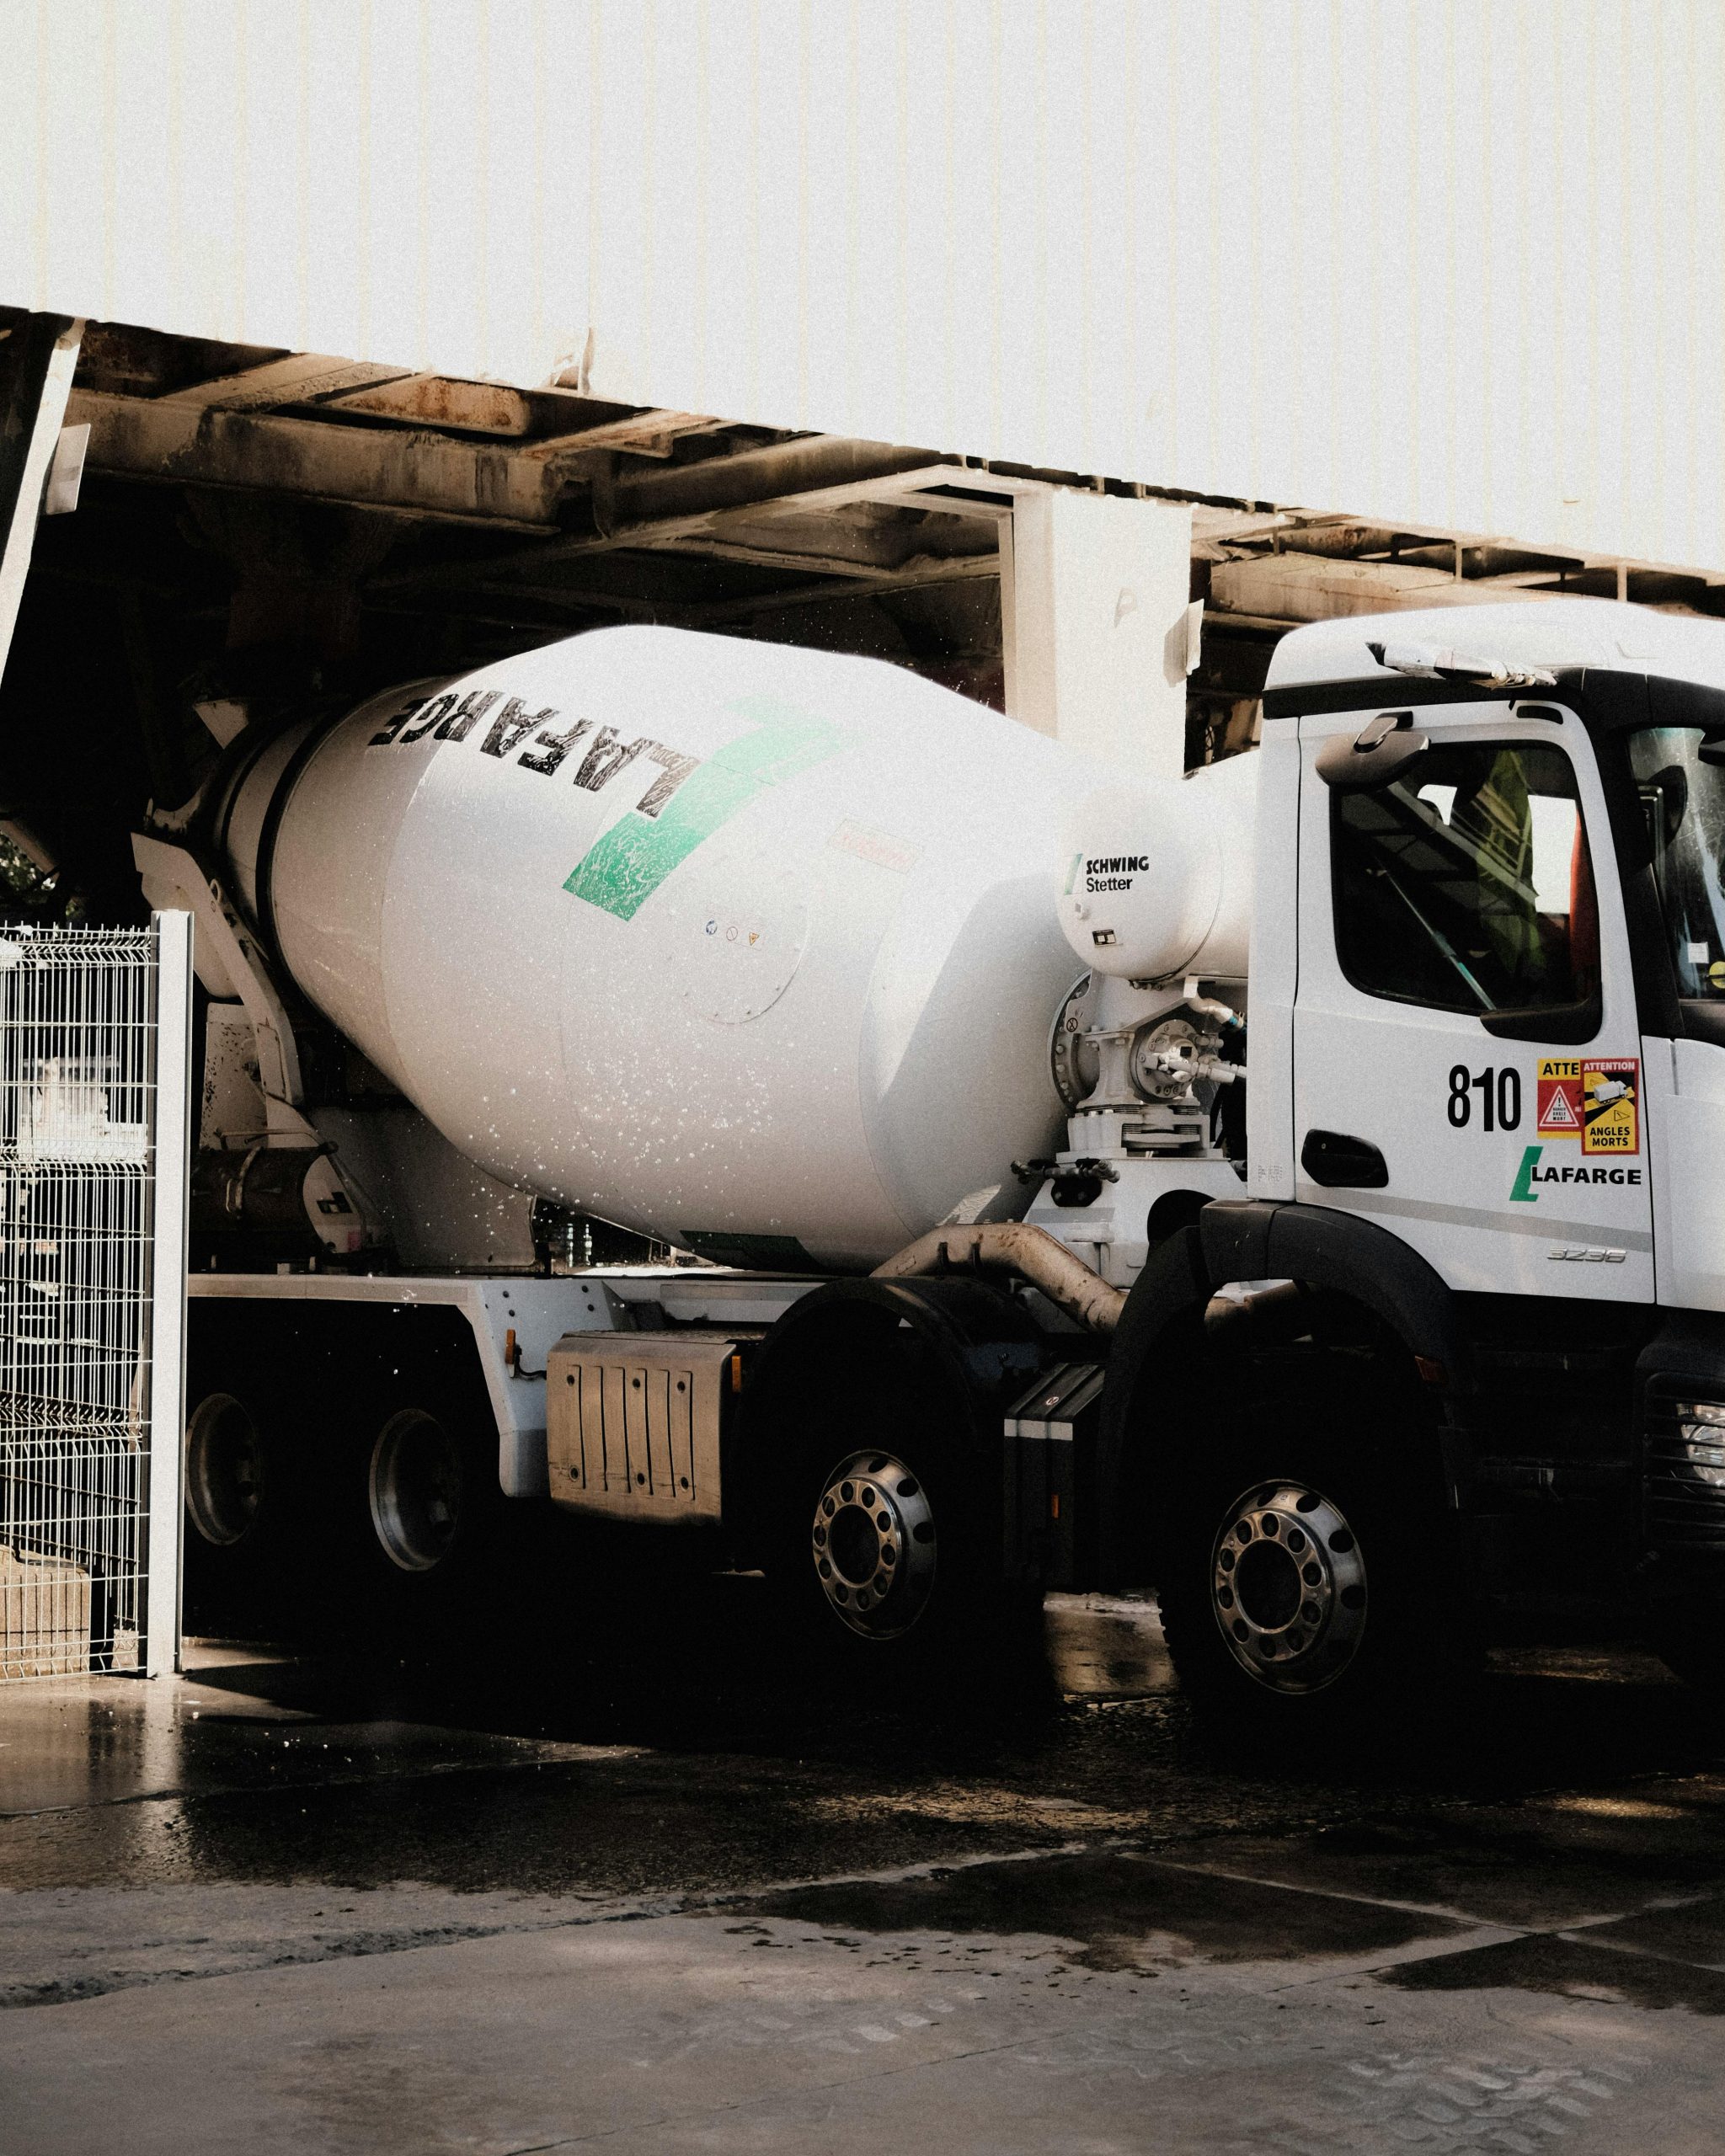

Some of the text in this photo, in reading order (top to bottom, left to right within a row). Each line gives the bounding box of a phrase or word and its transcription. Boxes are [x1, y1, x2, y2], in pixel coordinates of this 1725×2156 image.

[367, 690, 702, 819] LAFARGE
[1086, 856, 1149, 874] SCHWING
[1086, 877, 1133, 893] Stetter
[1583, 1062, 1635, 1071] ATTENTION
[1447, 1064, 1521, 1132] 810
[1589, 1127, 1631, 1136] ANGLES
[1592, 1137, 1629, 1146] MORTS
[1531, 1166, 1642, 1185] LAFARGE
[1546, 1247, 1627, 1263] 3236
